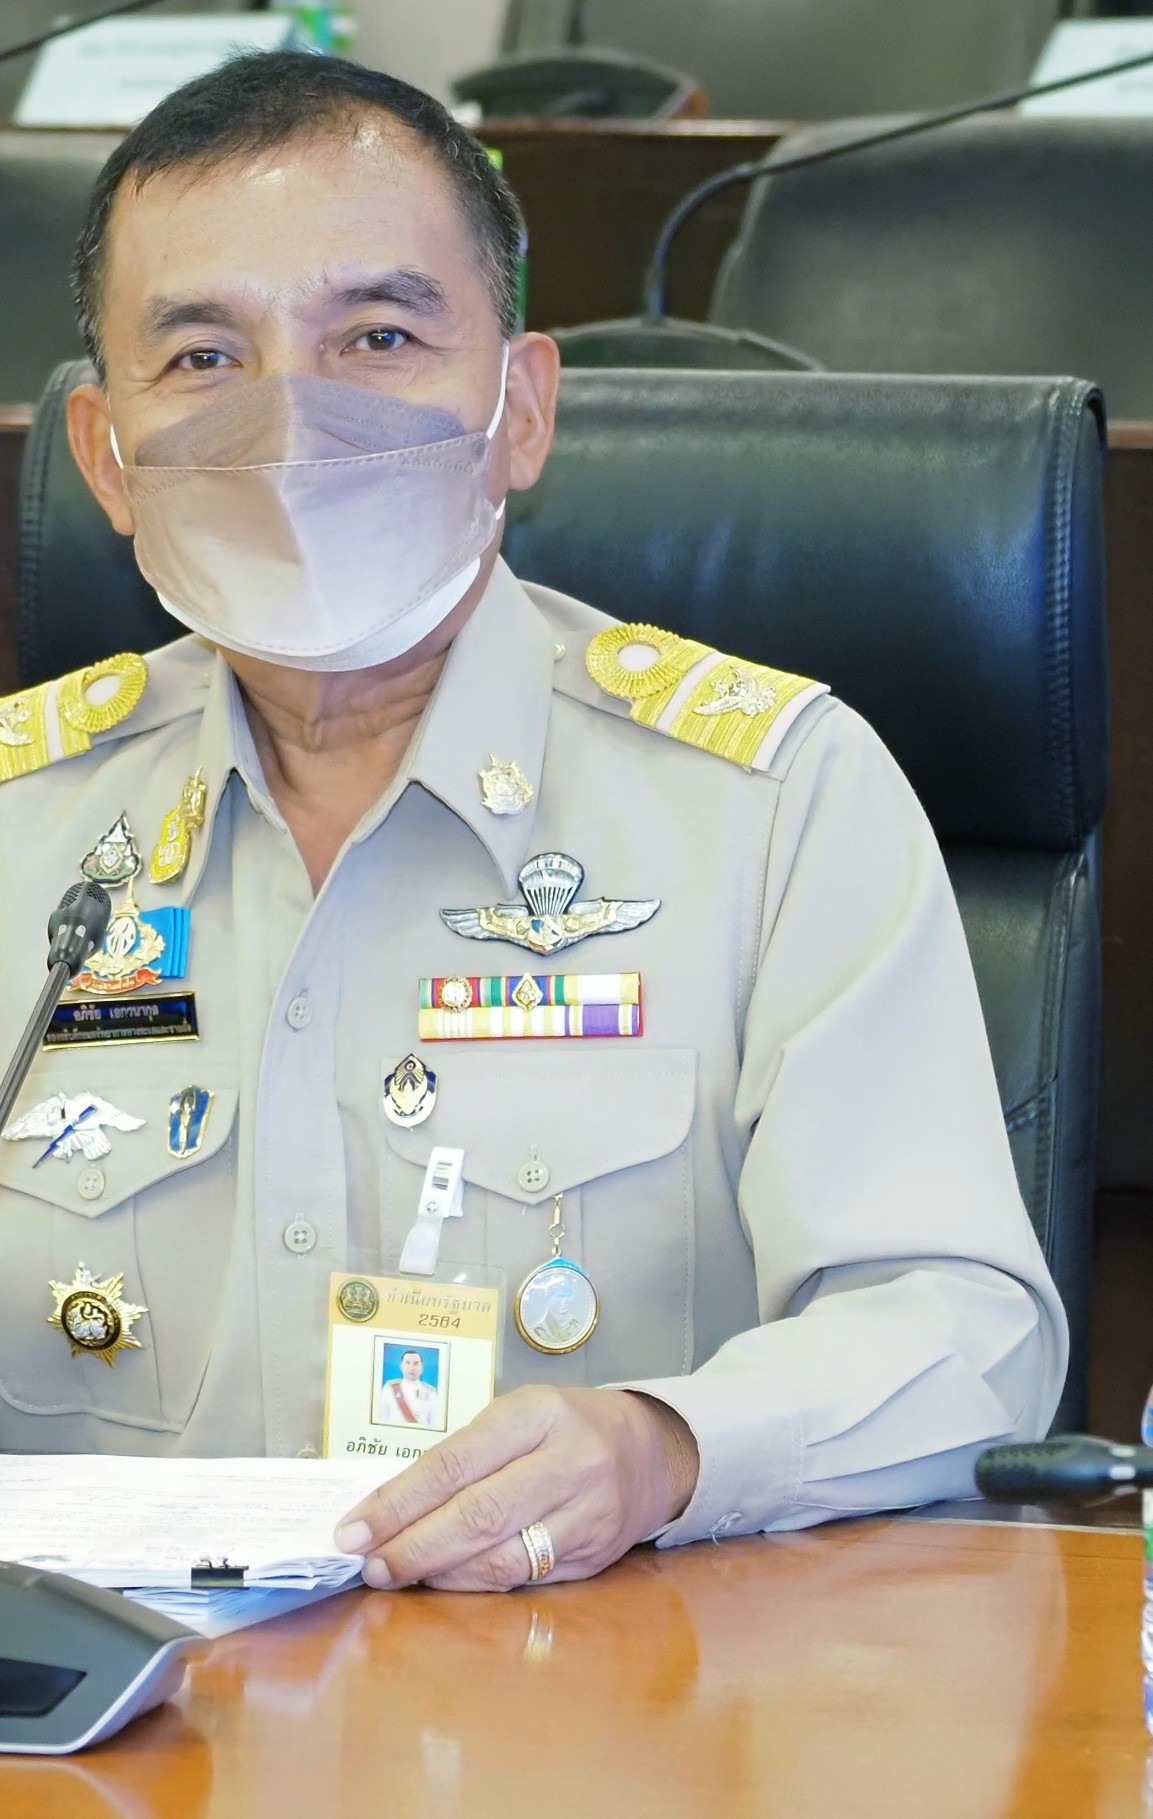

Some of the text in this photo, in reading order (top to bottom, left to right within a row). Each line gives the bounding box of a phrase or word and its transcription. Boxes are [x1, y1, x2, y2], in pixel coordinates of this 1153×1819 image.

[418, 1313, 461, 1329] 2564
[346, 1436, 430, 1459] อภิชัย เอก
